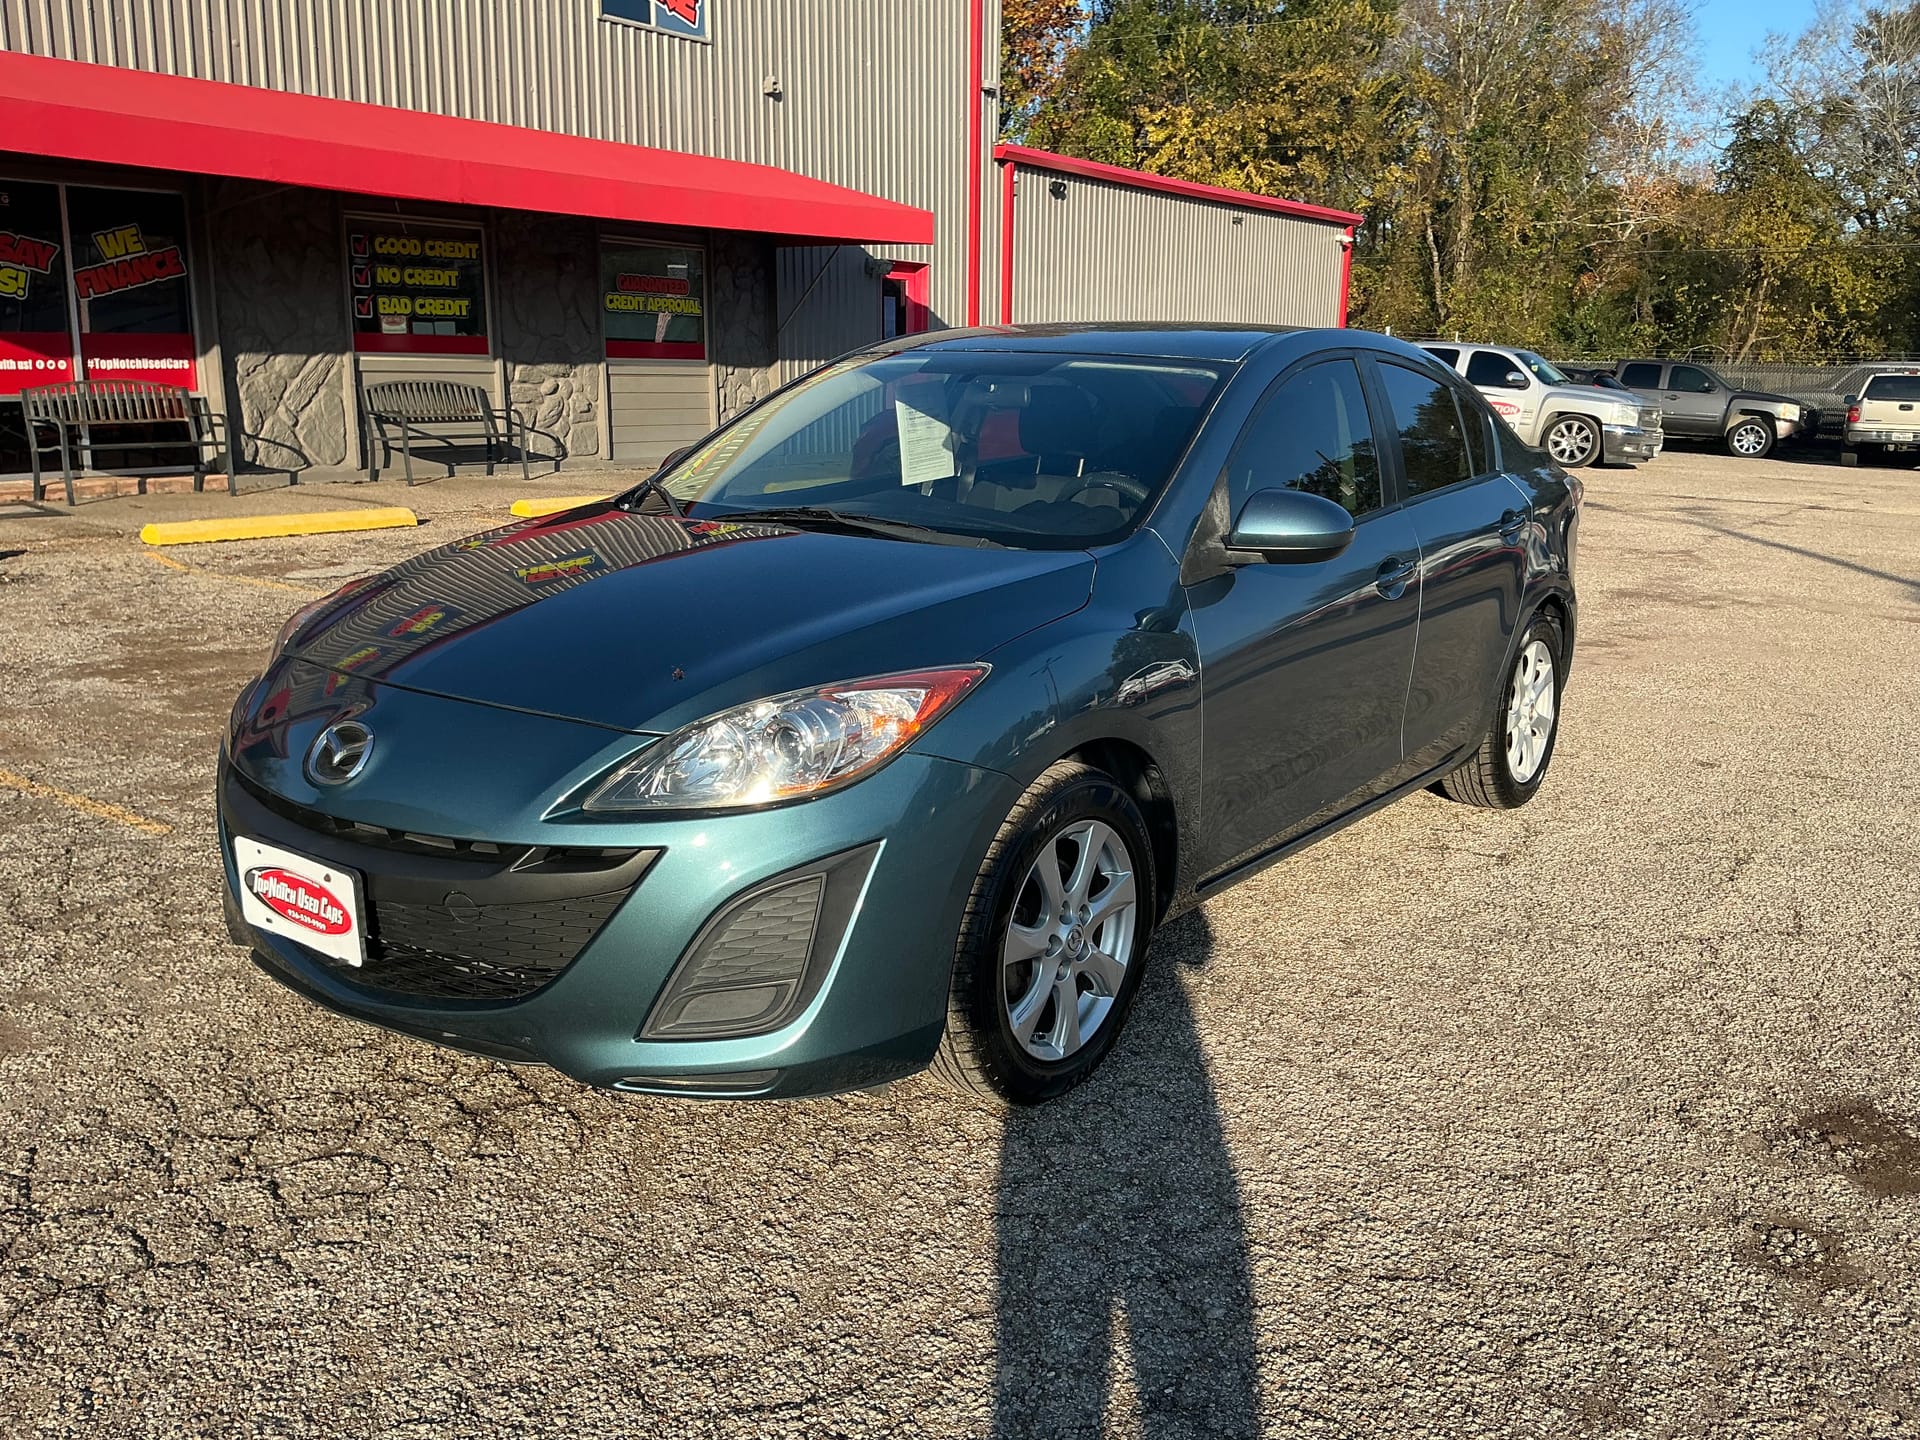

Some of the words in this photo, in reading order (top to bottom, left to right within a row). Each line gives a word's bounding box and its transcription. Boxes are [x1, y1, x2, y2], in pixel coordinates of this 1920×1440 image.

[0, 233, 58, 270] SAY
[96, 226, 142, 258] WE
[374, 236, 422, 257] GOOD
[424, 240, 479, 259] CREDIT
[75, 248, 185, 298] FINANCE
[376, 266, 401, 285] NO
[403, 267, 460, 287] CREDIT
[619, 274, 688, 293] GUARANTEED
[377, 296, 413, 315] BAD
[415, 298, 470, 316] CREDIT
[606, 294, 645, 311] CREDIT
[647, 296, 702, 315] APPROVAL
[87, 357, 190, 370] #TopNotchUsedCars
